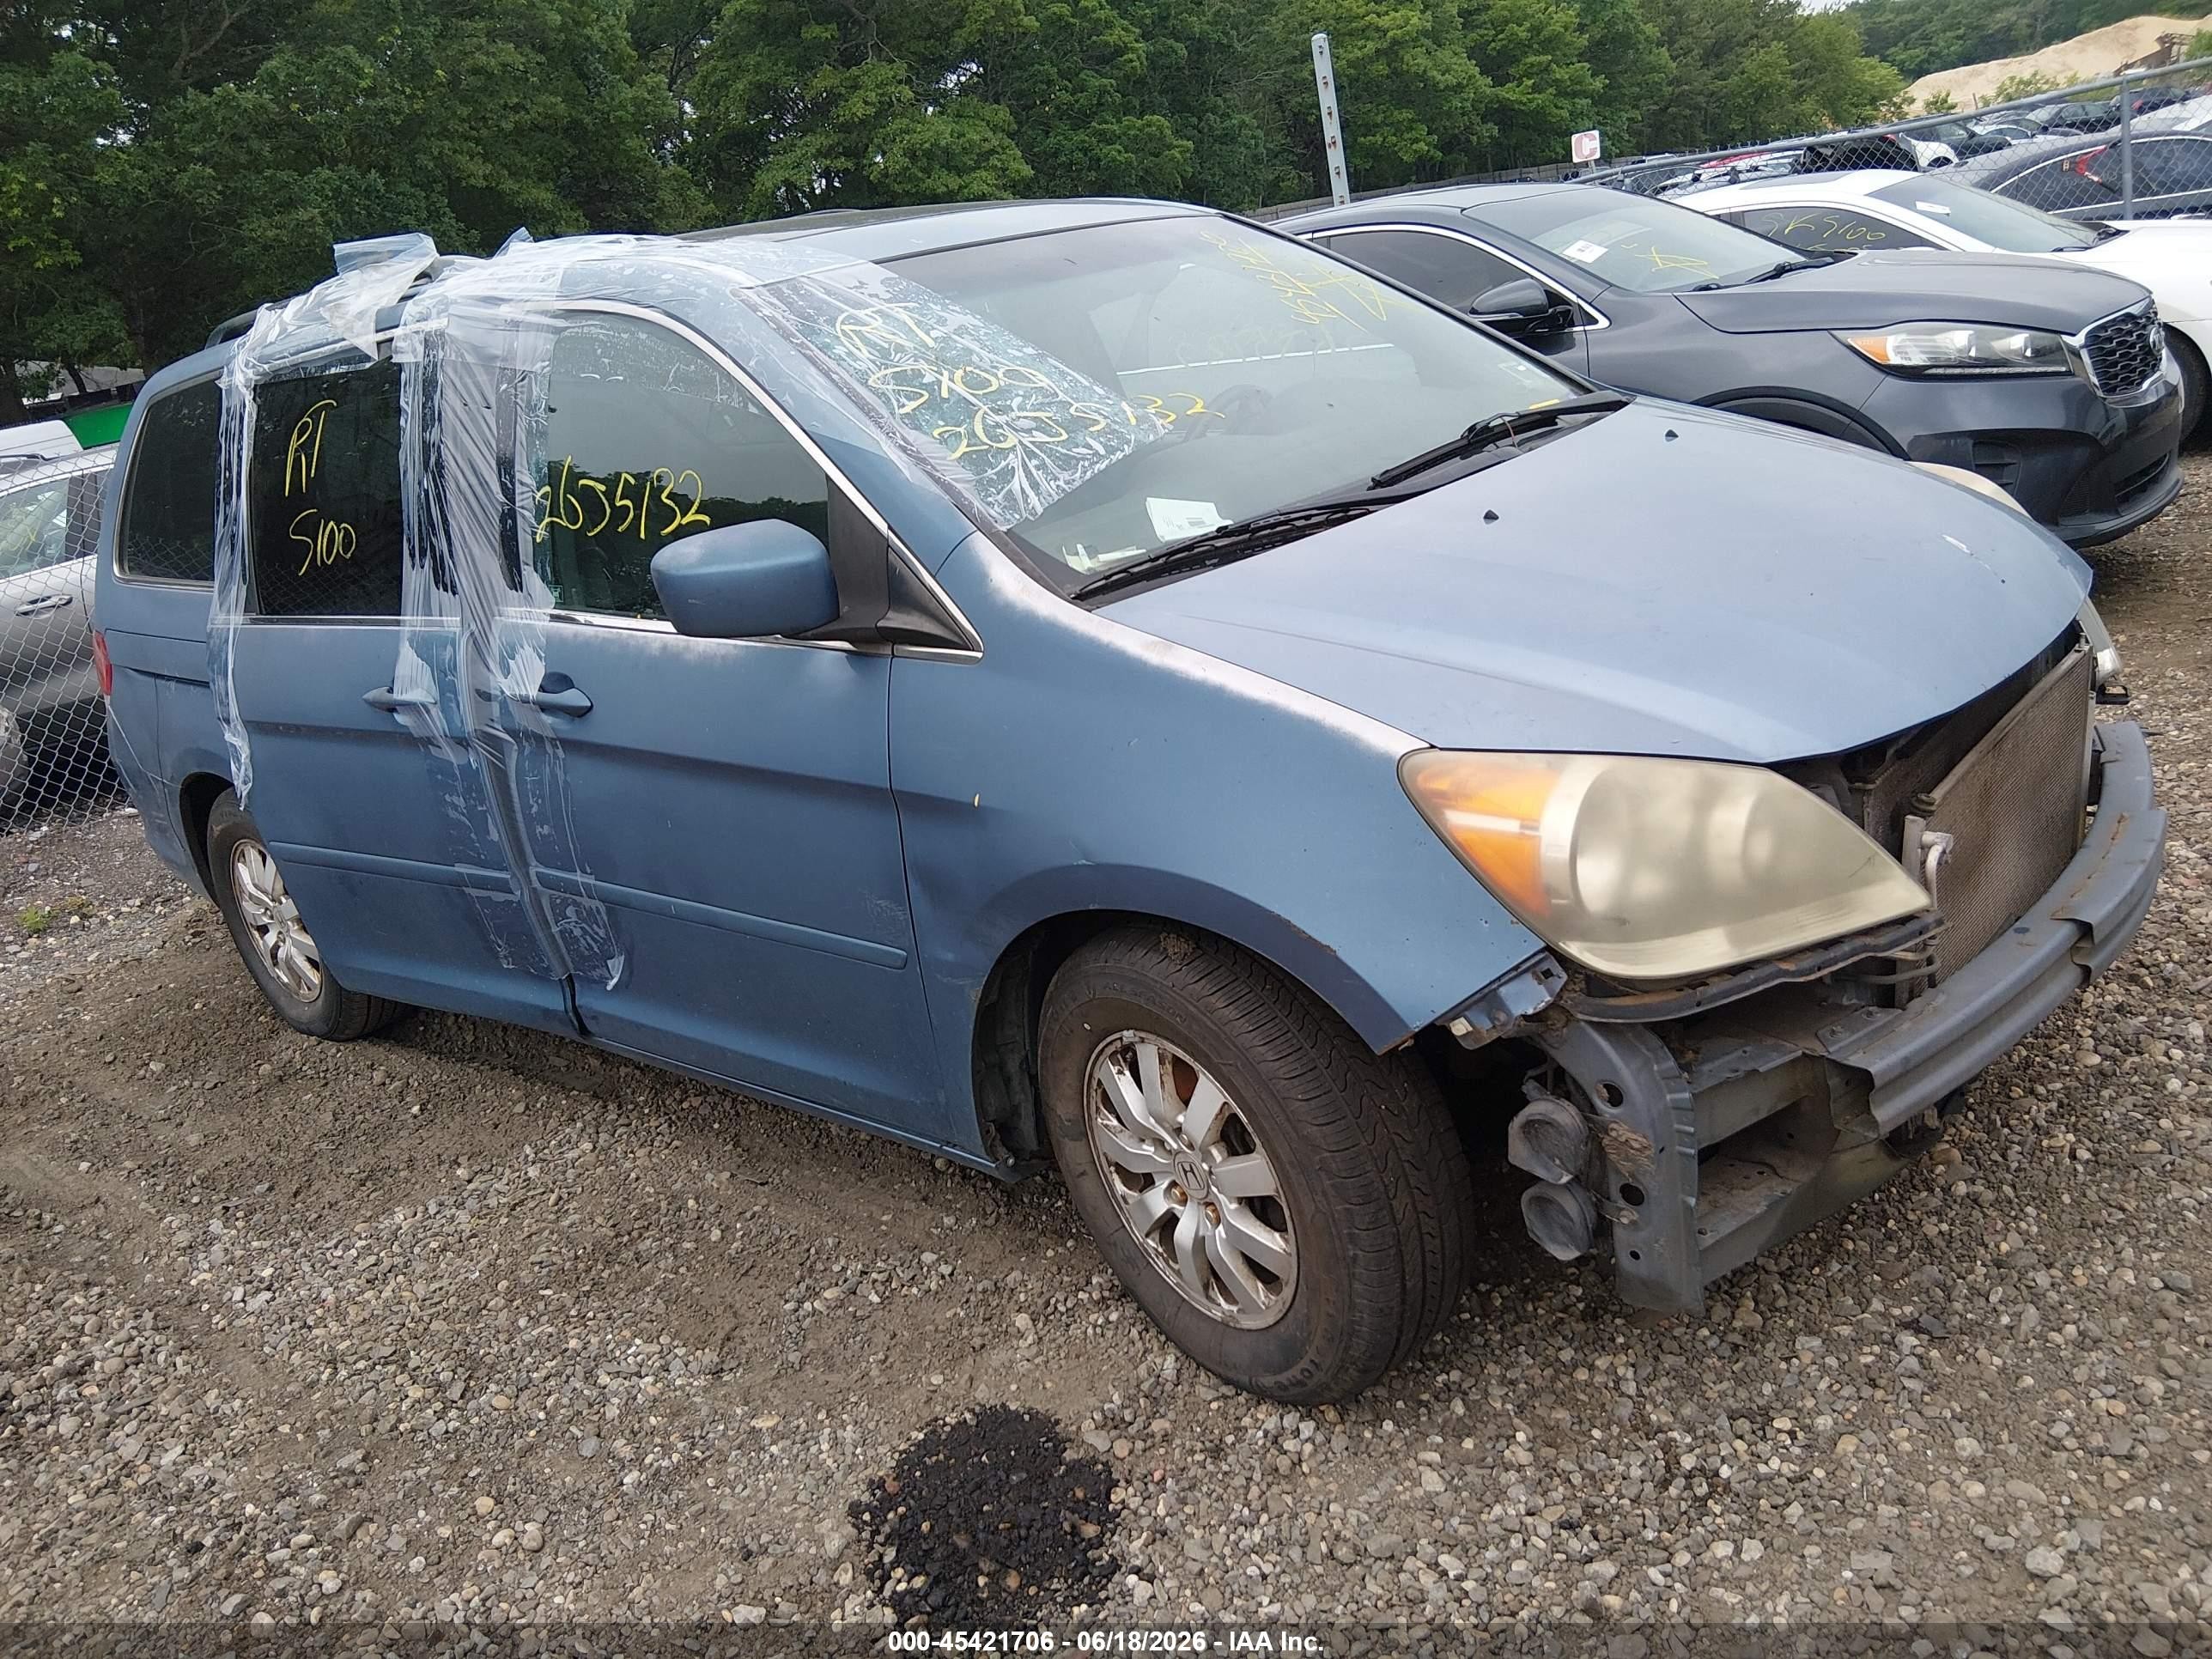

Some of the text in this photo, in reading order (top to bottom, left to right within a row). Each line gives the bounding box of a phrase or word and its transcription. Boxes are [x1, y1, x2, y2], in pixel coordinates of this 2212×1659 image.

[1574, 133, 1597, 159] C
[285, 399, 337, 496] RT
[535, 453, 712, 544] 2655132
[289, 508, 356, 576] S100
